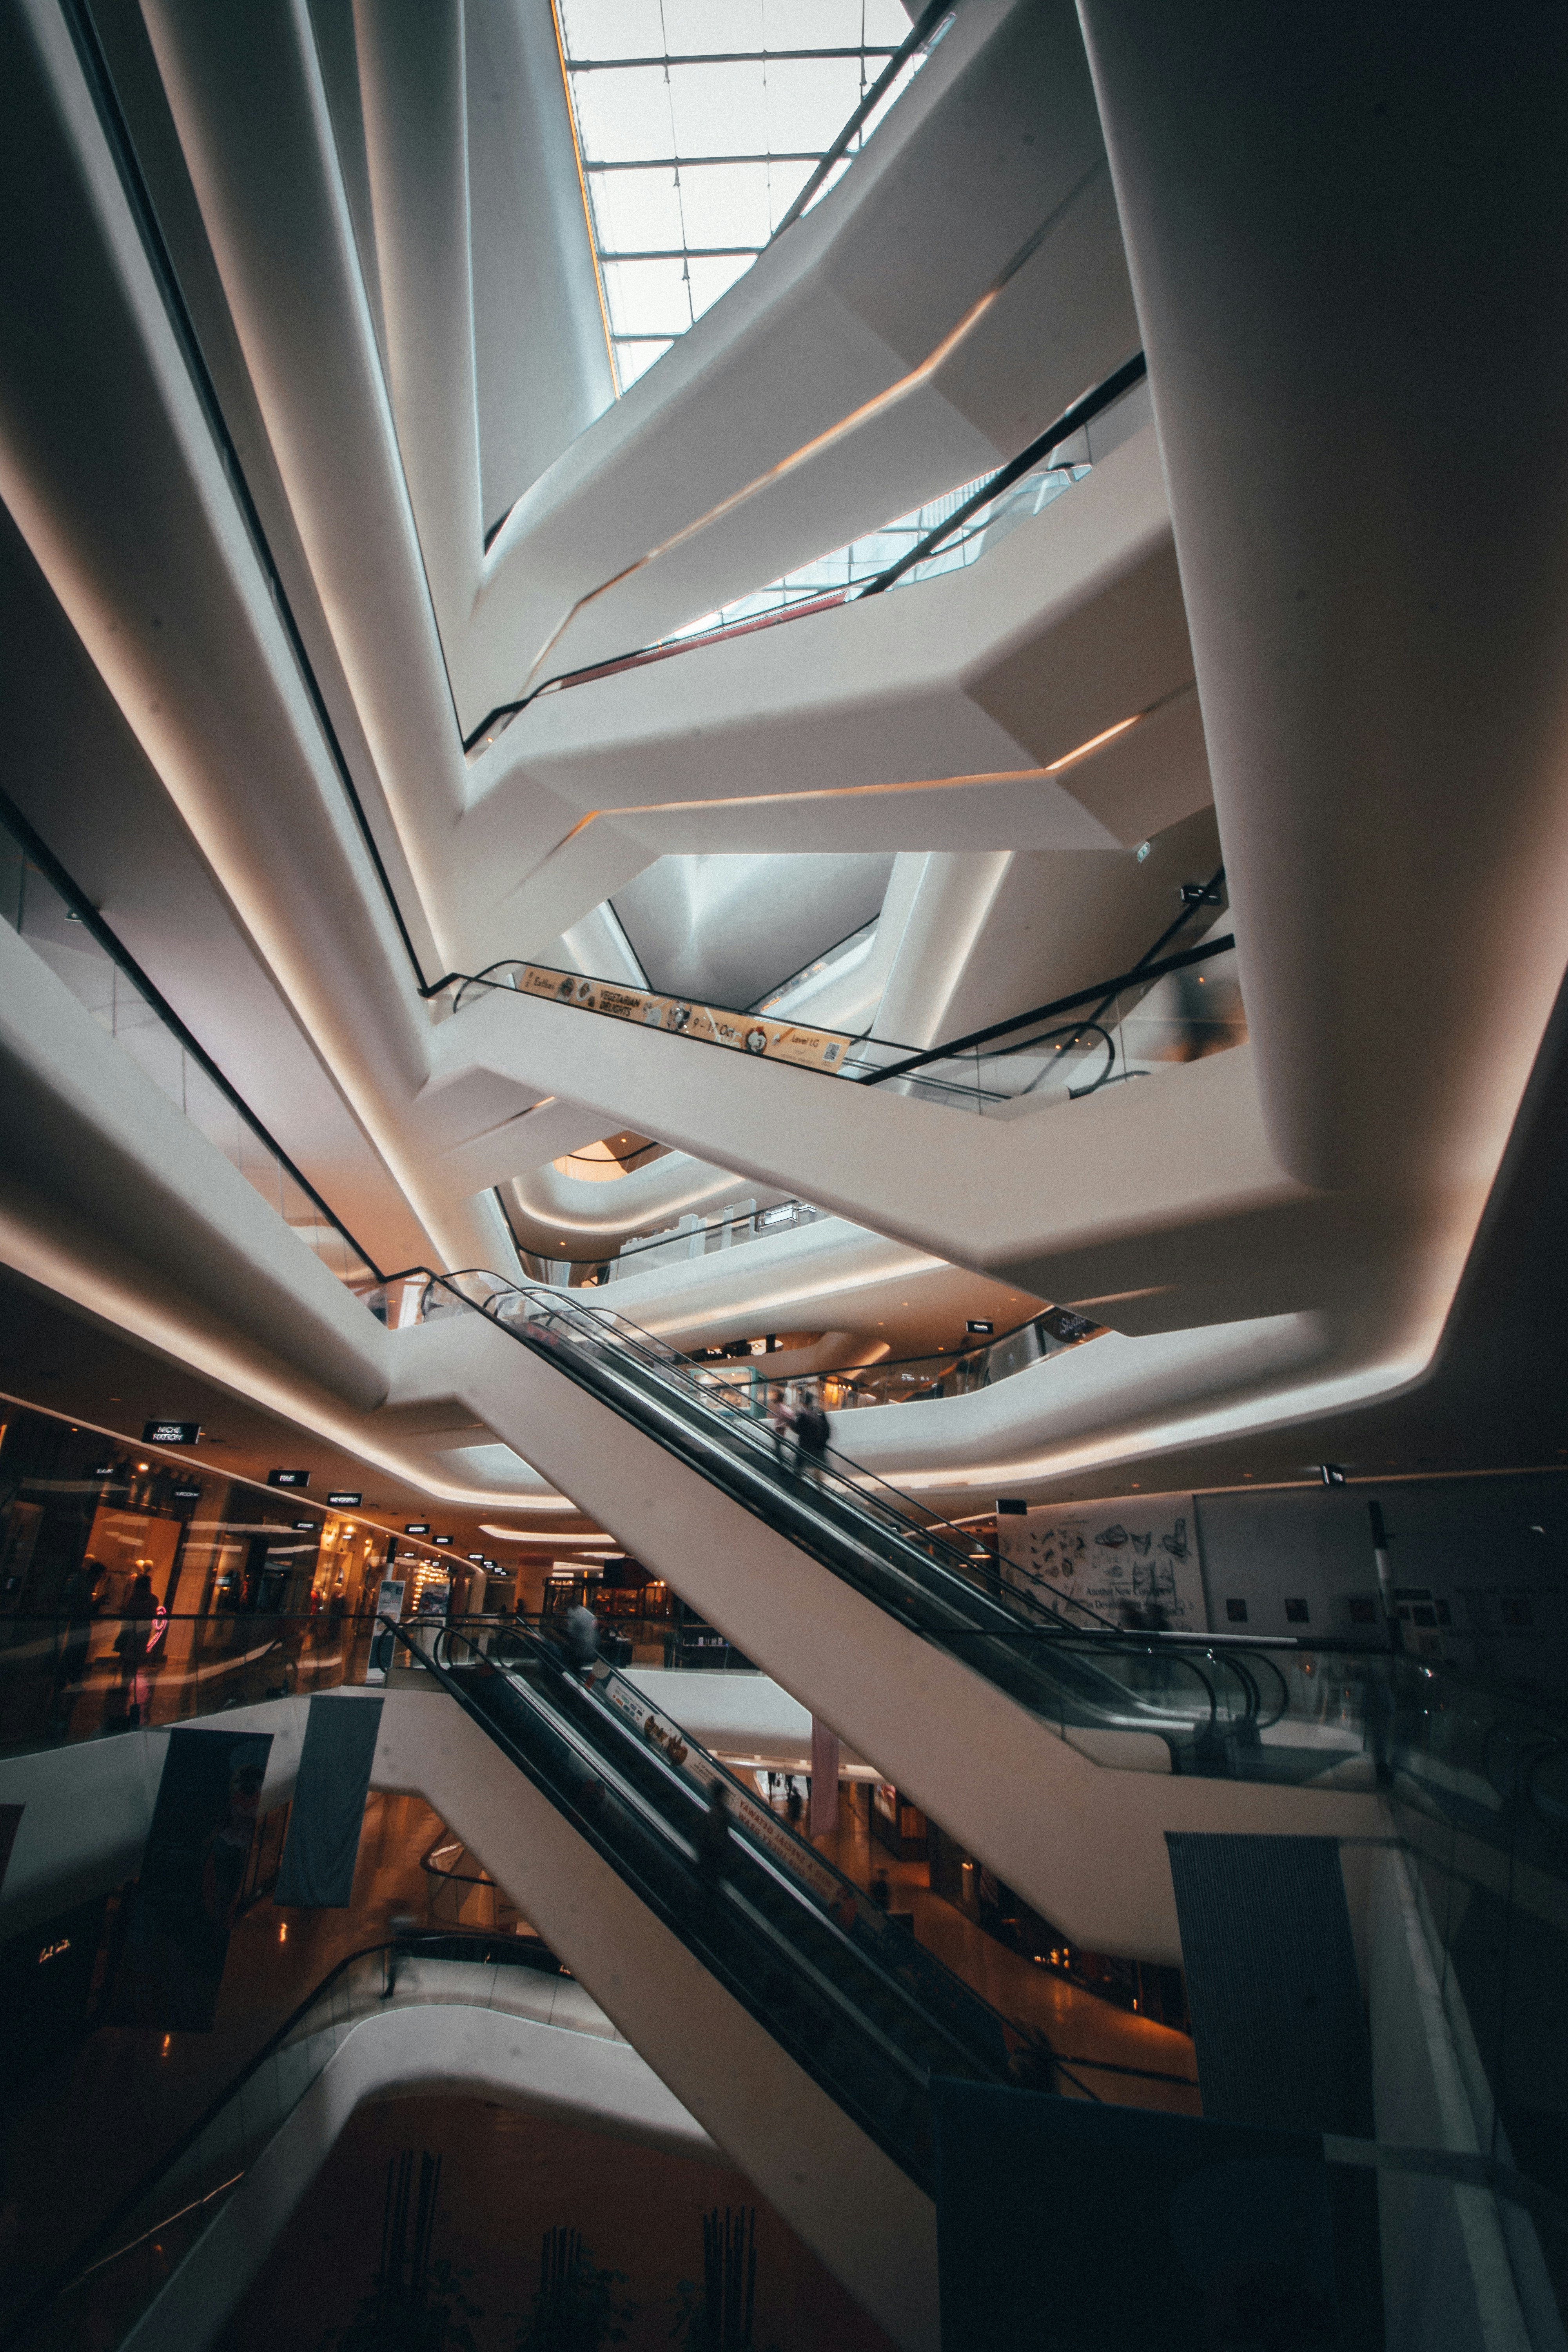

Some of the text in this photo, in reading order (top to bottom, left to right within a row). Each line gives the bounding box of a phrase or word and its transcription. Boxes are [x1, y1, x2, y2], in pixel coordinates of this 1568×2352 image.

[601, 990, 641, 1007] VEGETARIAN
[599, 1000, 632, 1016] DELIGHTS
[693, 1018, 699, 1027] 9
[791, 1034, 820, 1048] Level LG
[152, 1433, 183, 1441] NATION
[1115, 1586, 1131, 1595] New
